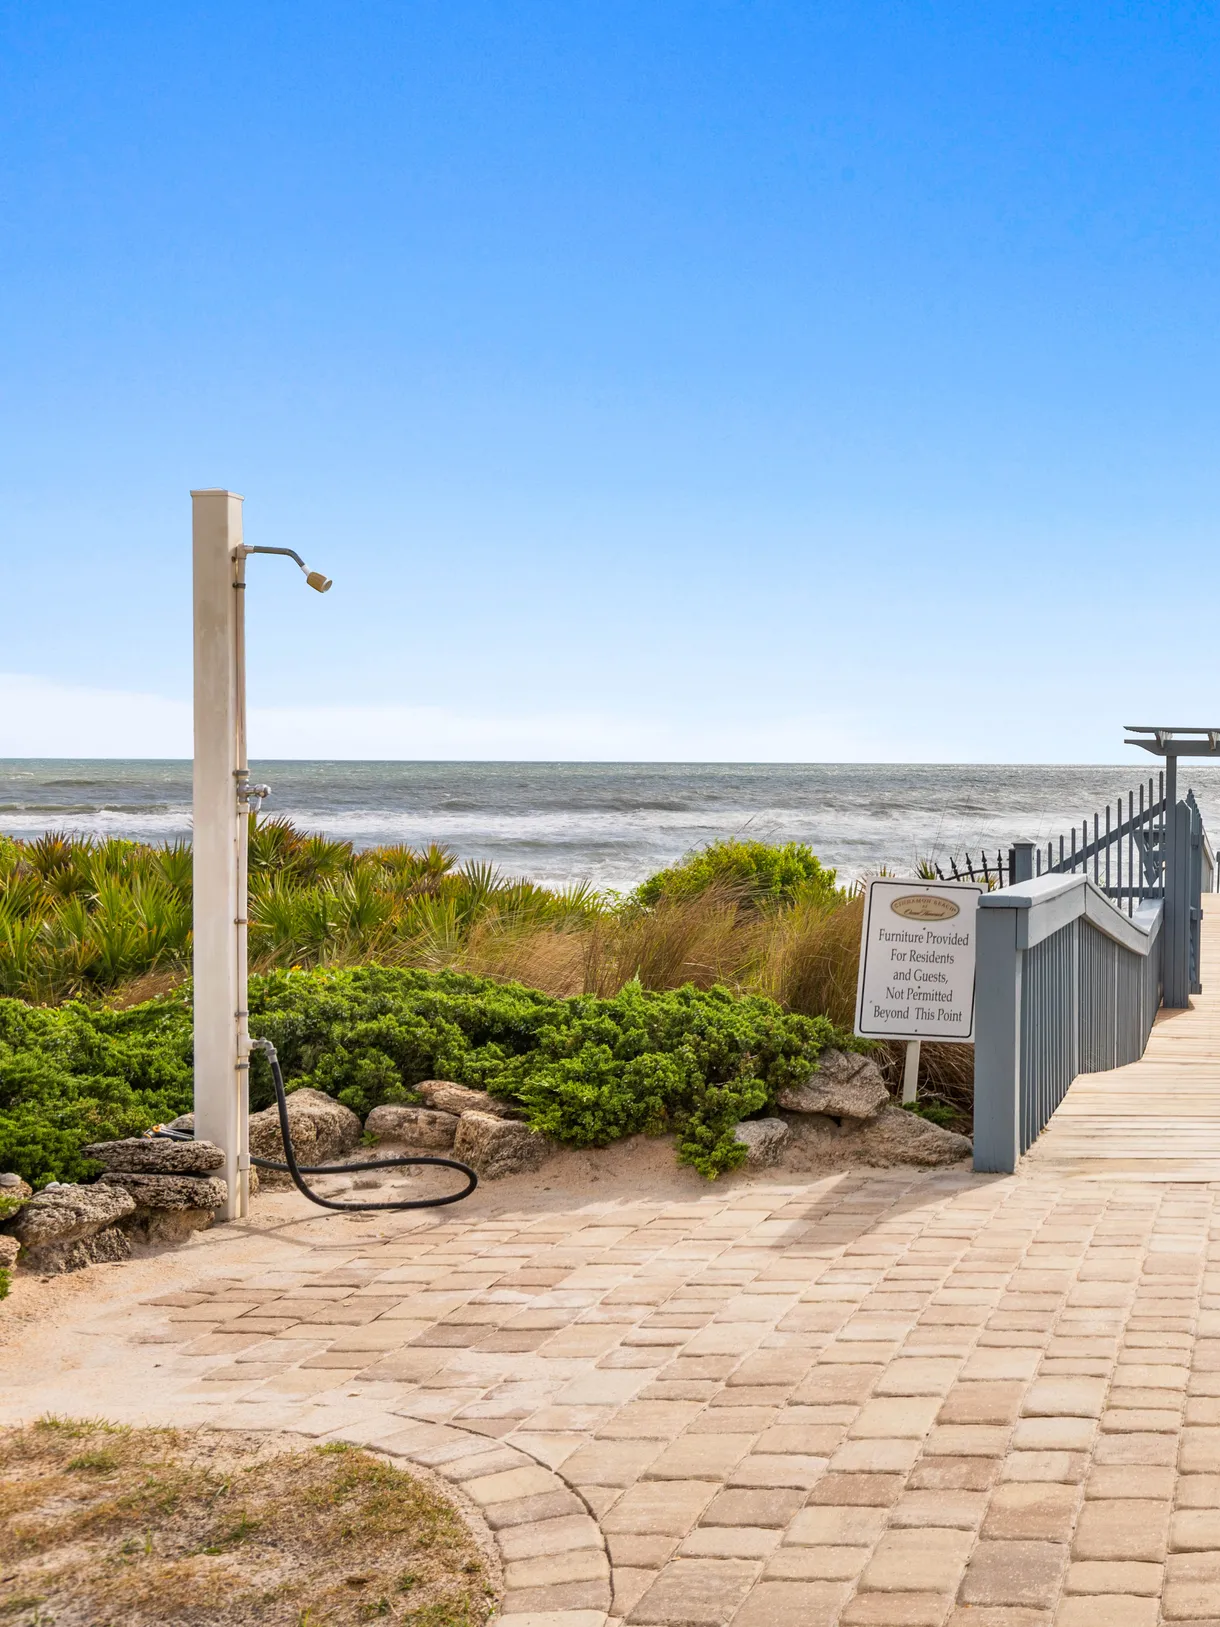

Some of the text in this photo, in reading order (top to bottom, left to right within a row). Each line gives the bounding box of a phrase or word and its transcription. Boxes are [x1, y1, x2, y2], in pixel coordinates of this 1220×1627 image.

[879, 928, 969, 946] Furniture Provided
[891, 949, 954, 964] For Residents
[893, 968, 948, 984] and Guests,
[886, 987, 952, 1002] Not Permitted
[873, 1005, 962, 1022] Beyond This Point
